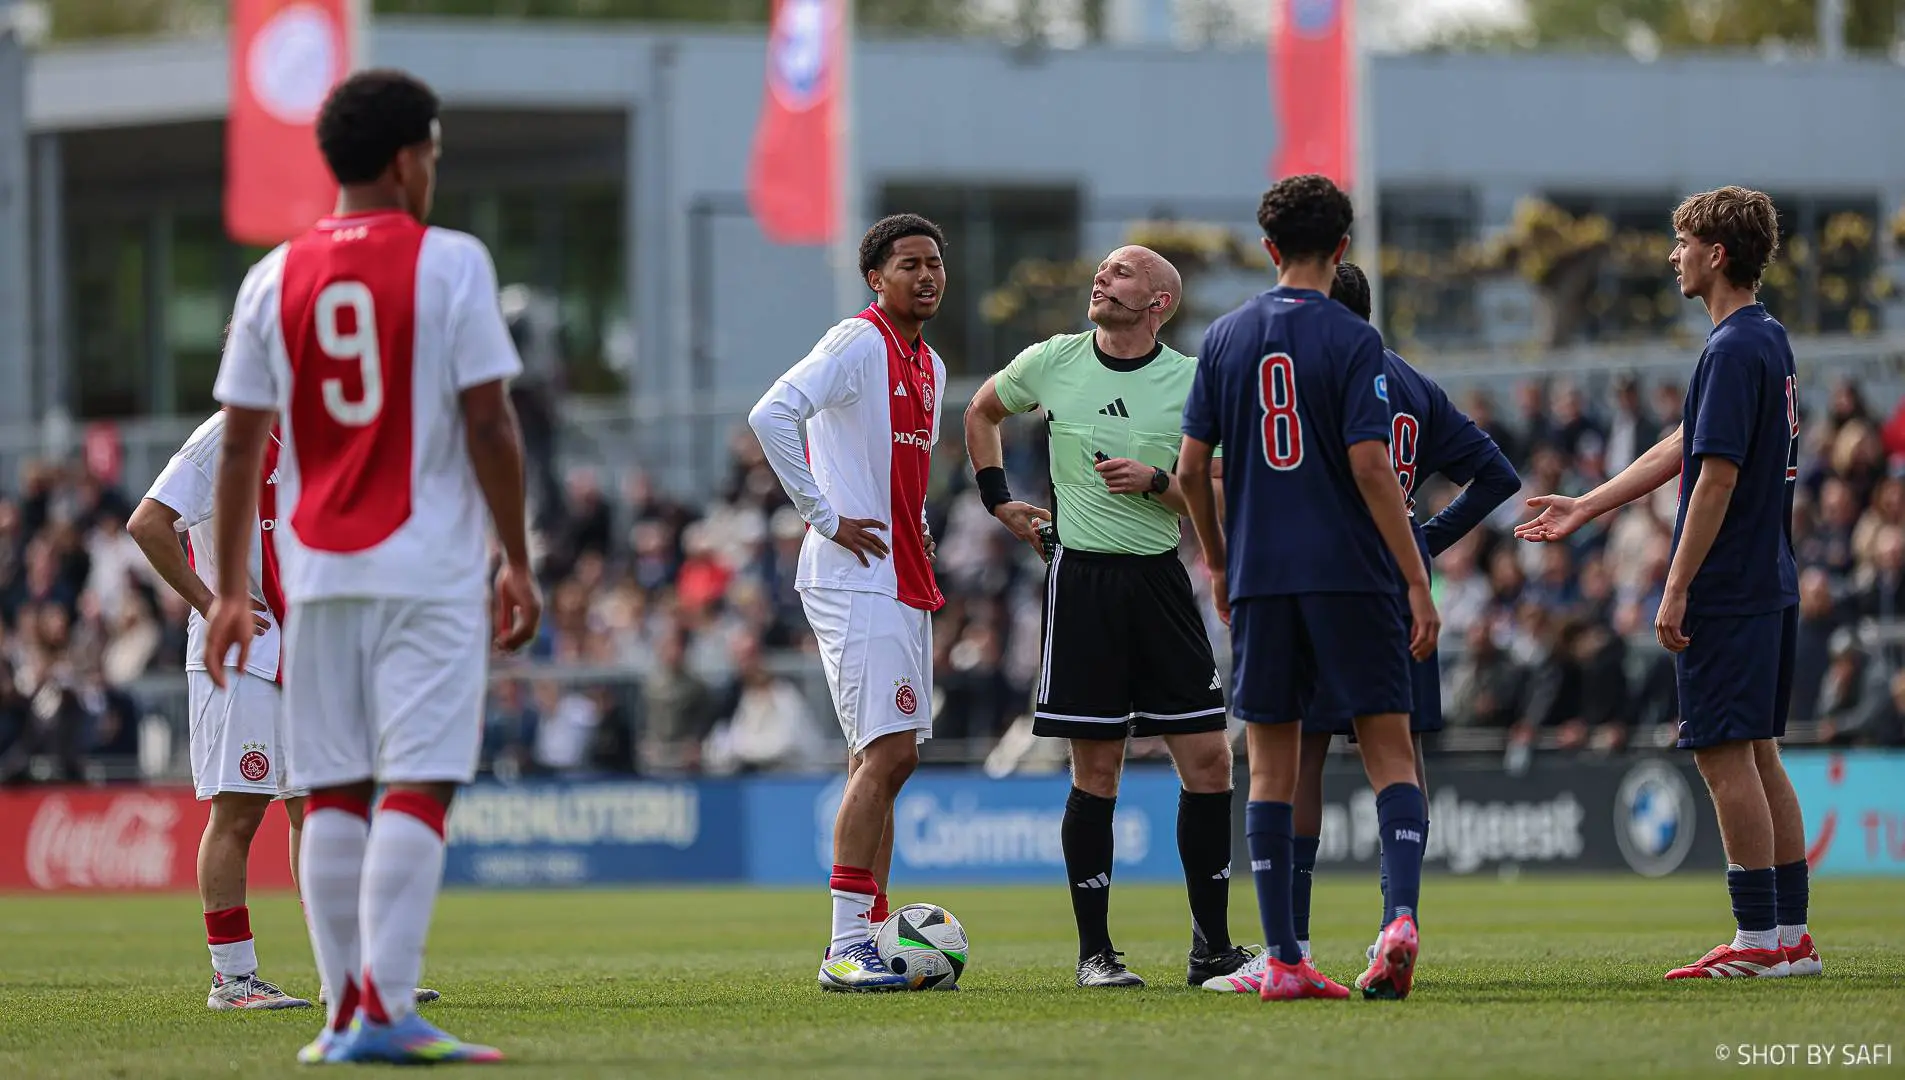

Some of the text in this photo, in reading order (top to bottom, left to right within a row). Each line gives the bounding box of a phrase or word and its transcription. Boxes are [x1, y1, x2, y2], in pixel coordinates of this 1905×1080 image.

[314, 280, 384, 427] 9
[1258, 351, 1304, 471] 8
[1395, 829, 1421, 843] PARIS
